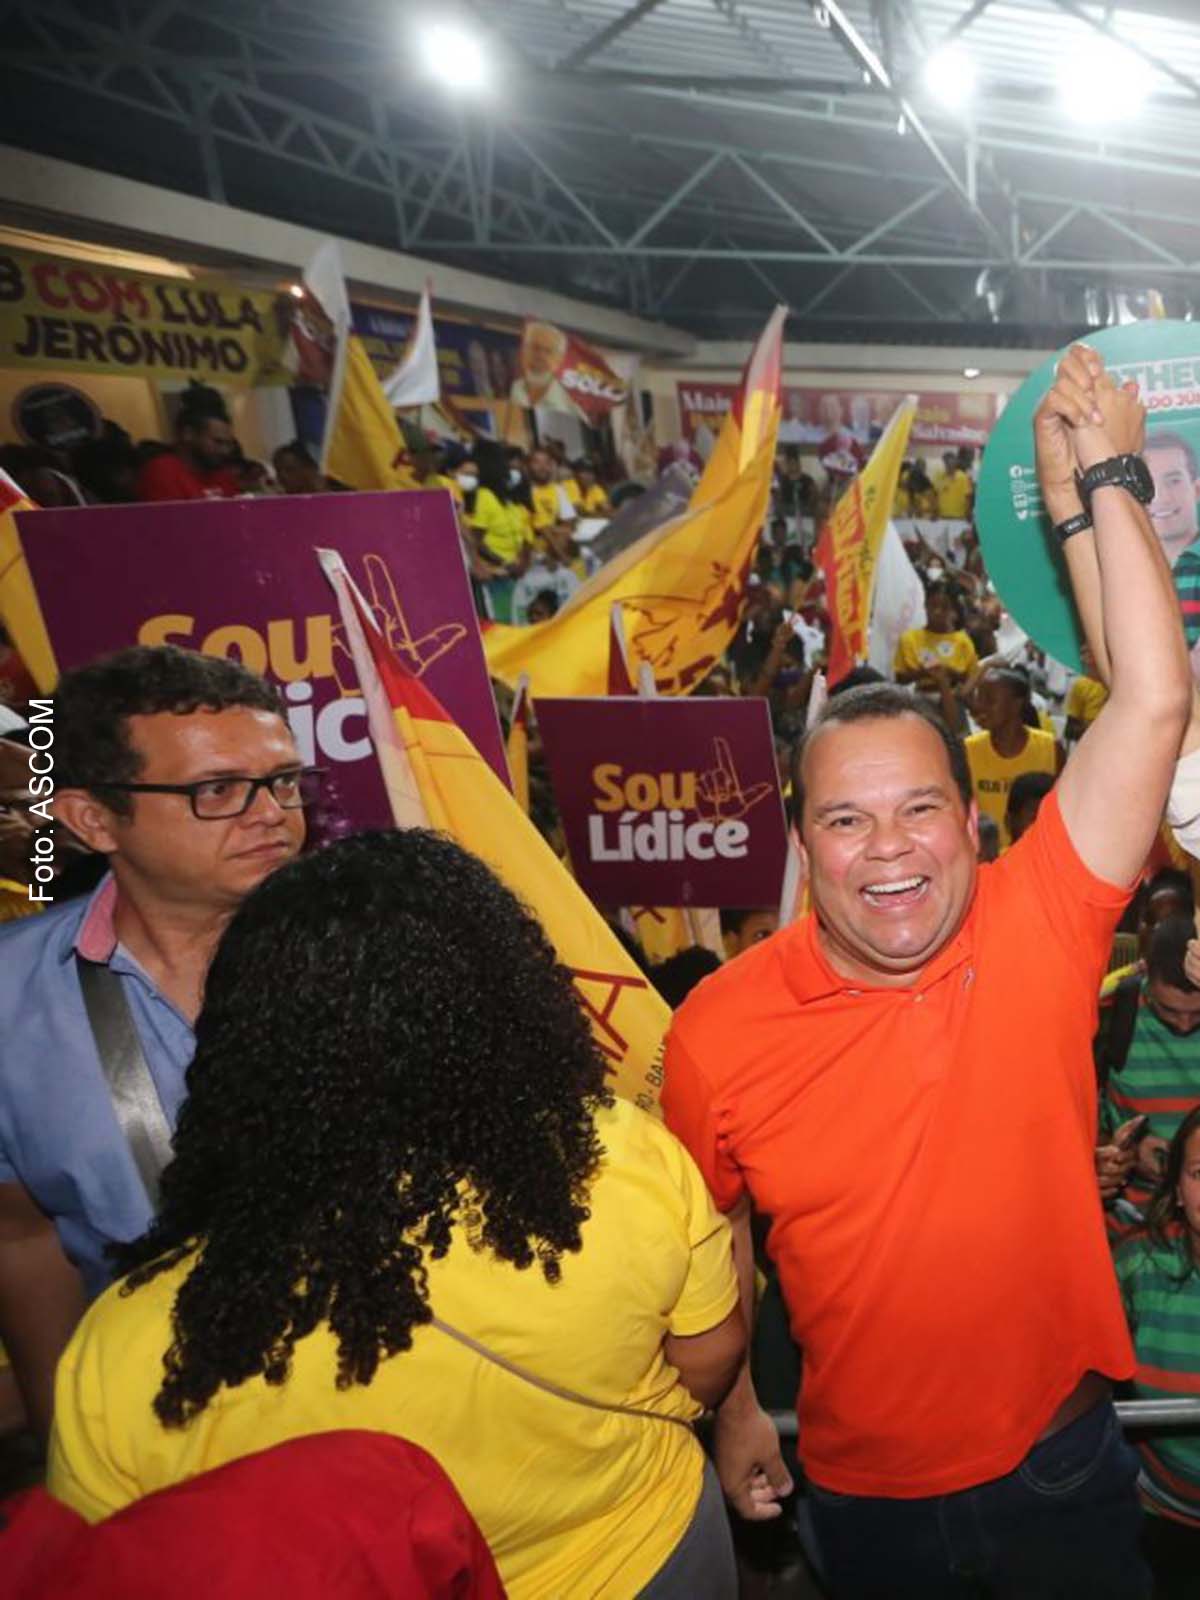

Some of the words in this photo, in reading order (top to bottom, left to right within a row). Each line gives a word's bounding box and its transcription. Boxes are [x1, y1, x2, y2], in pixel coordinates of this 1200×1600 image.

[31, 262, 150, 318] COM
[156, 284, 263, 334] LULA
[14, 312, 248, 373] JERÔNIMO
[593, 763, 698, 812] Sou
[588, 809, 750, 862] Lídice
